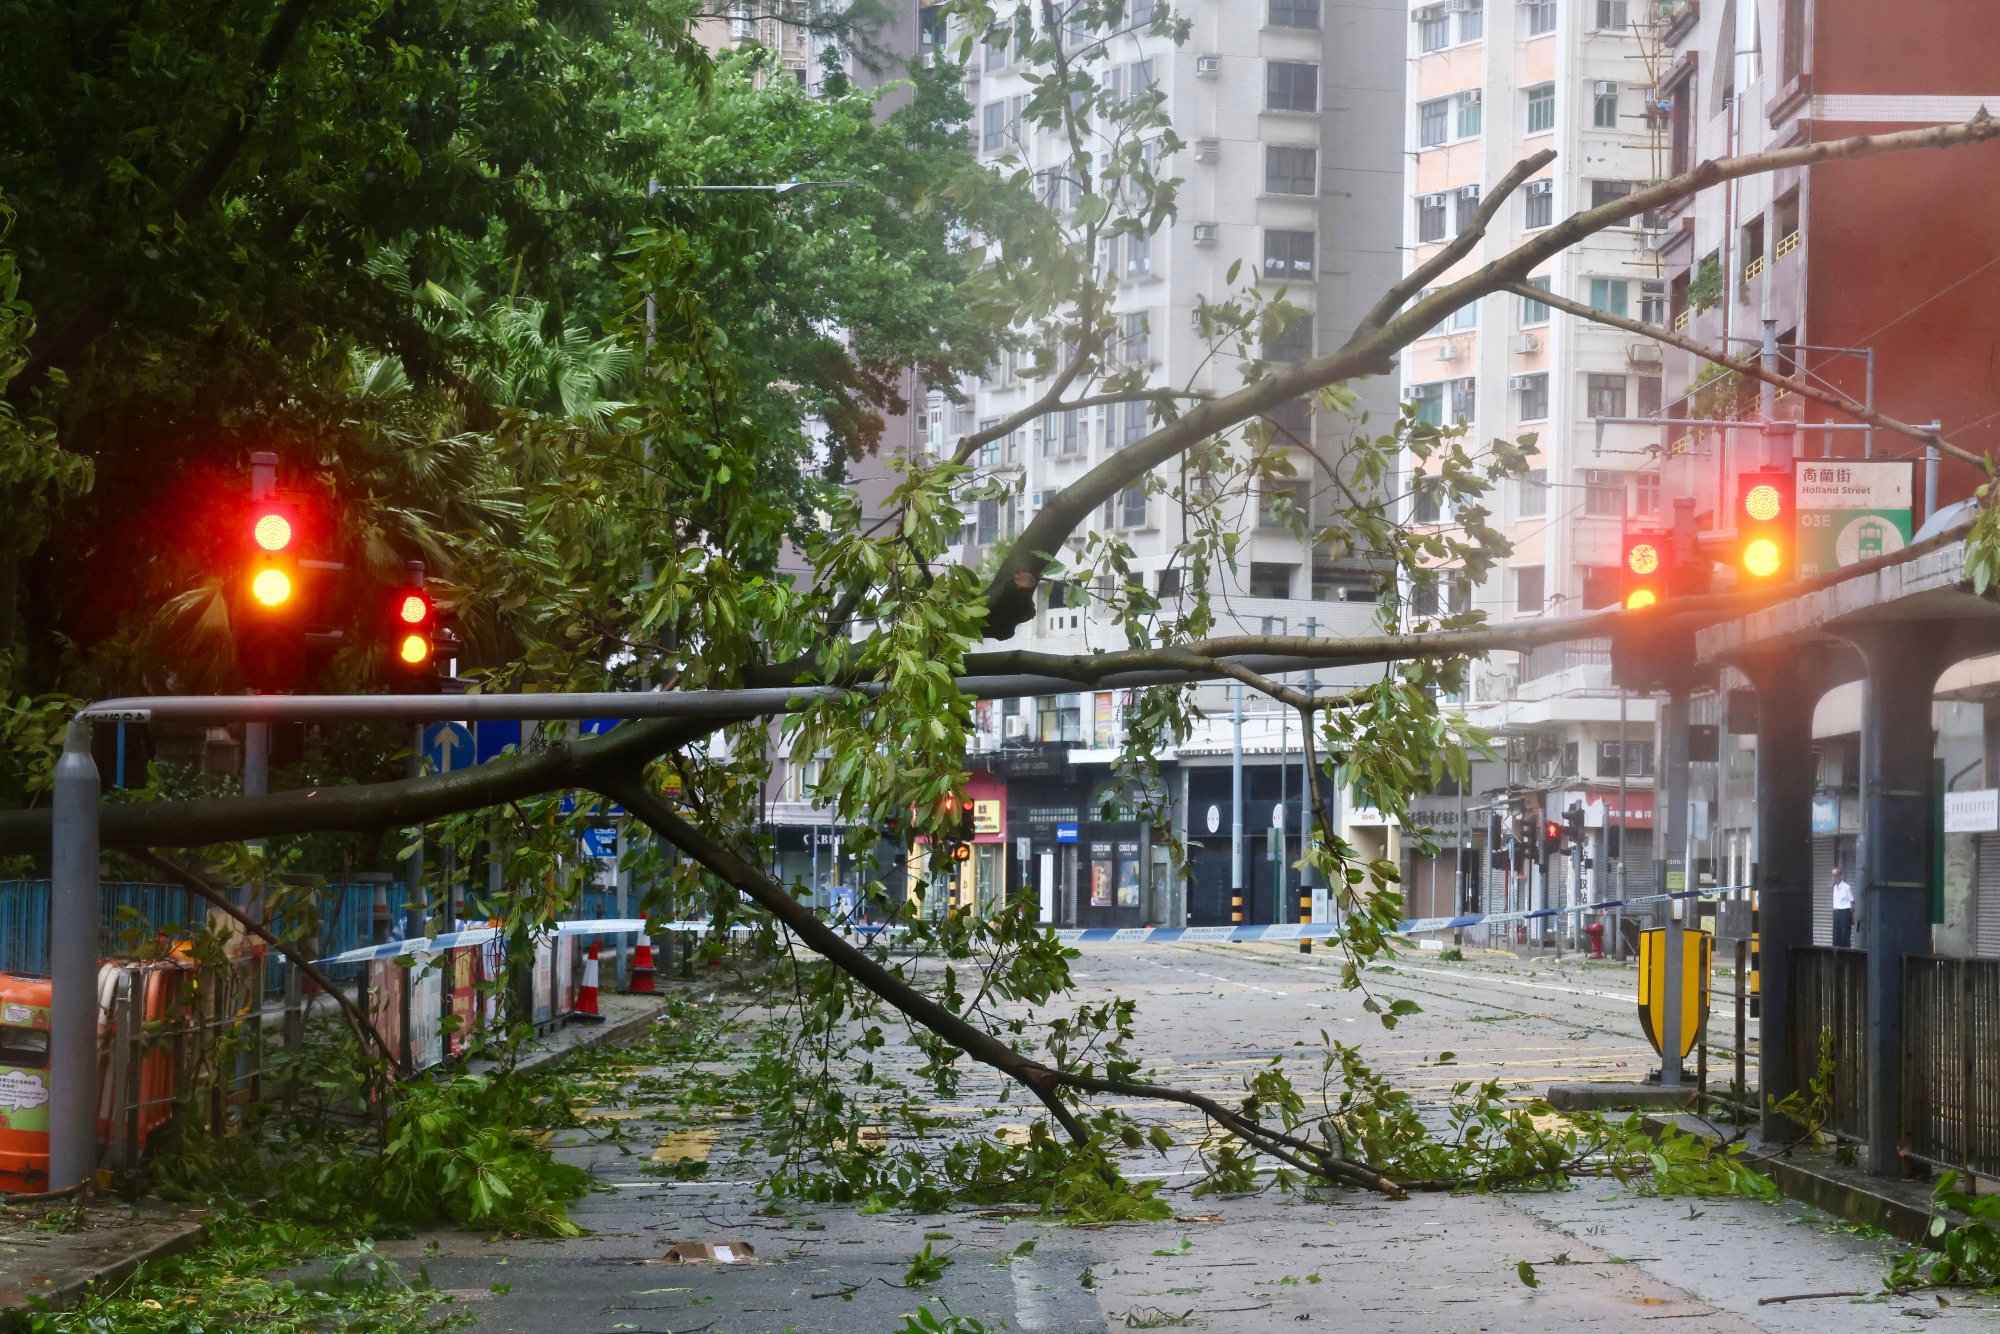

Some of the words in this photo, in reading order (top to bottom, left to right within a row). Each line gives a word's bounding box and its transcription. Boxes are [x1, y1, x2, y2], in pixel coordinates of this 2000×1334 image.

[1803, 468, 1851, 483] 荷蘭街
[1802, 486, 1838, 494] Holland
[1841, 486, 1871, 494] Street
